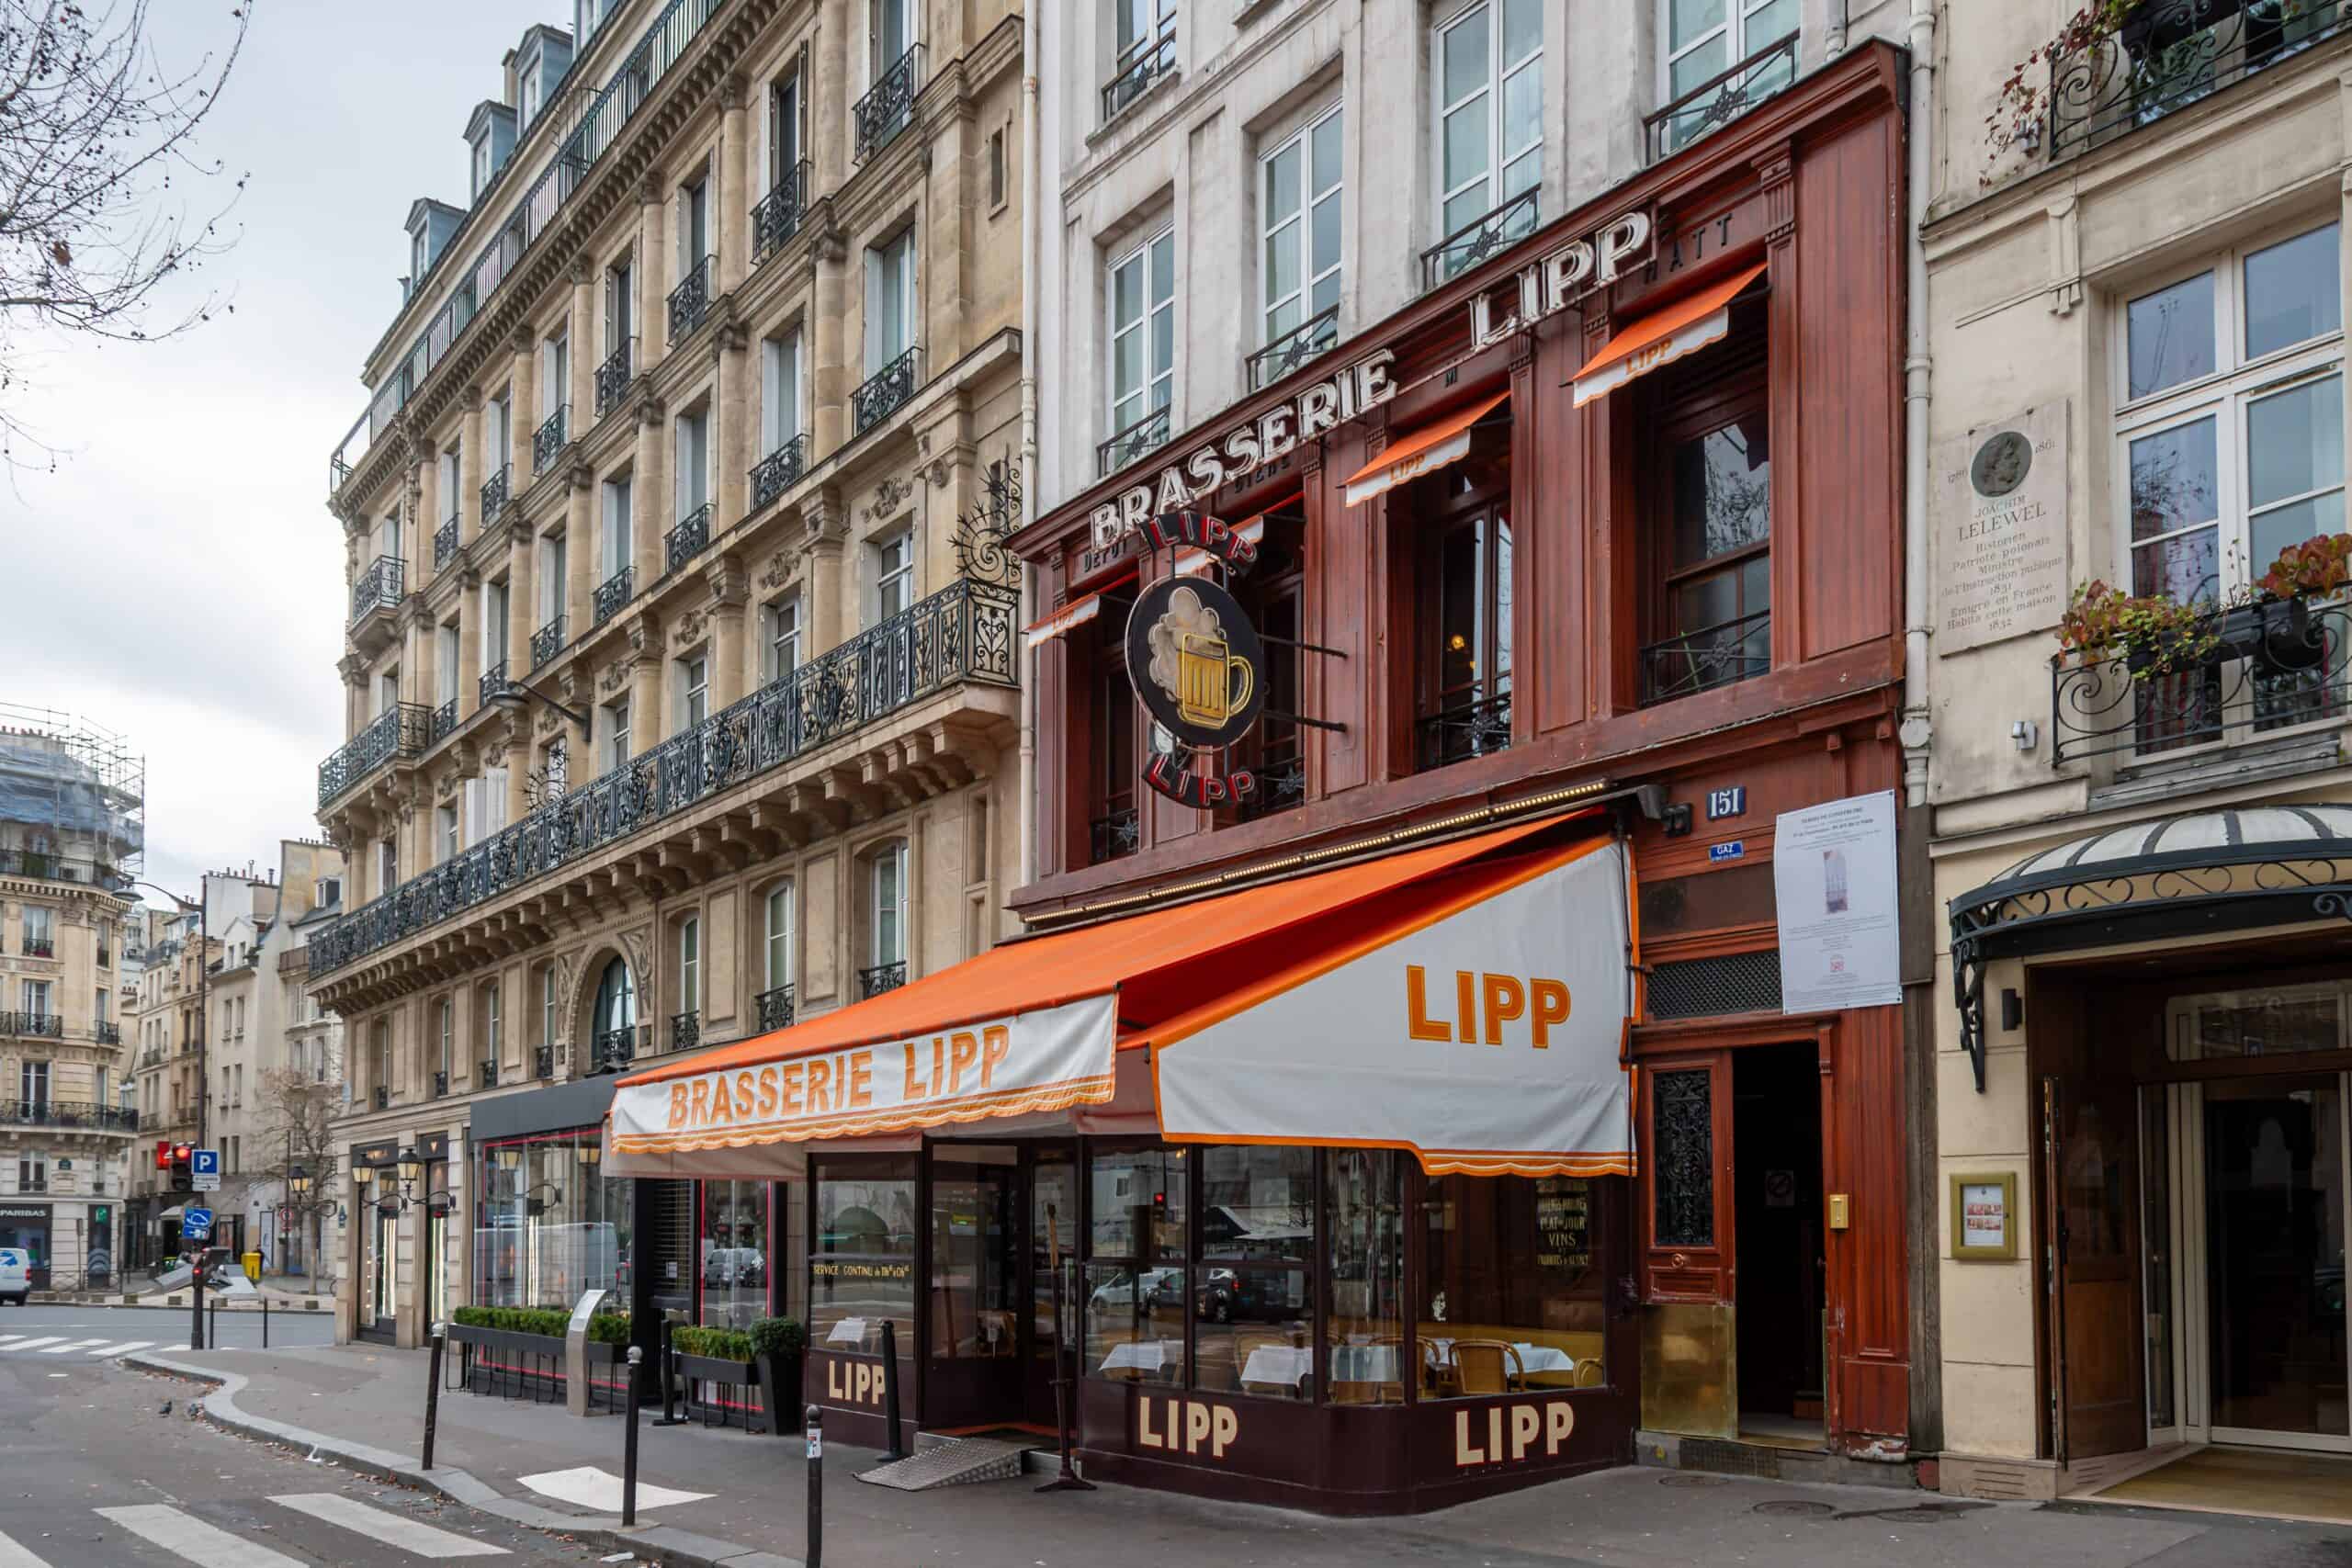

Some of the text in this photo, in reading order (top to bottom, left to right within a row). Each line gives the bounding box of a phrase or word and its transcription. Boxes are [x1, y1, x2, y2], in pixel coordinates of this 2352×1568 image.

[1624, 338, 1672, 376] LIPP
[1090, 211, 1652, 550] BRASSERIE LIPP
[1389, 455, 1426, 481] LIPP
[1957, 501, 2047, 542] LELEWEL
[1974, 494, 2026, 518] JOACHIM
[1149, 509, 1258, 563] LIPP
[1952, 536, 2051, 571] Patriote polonais
[1976, 532, 2026, 553] Historien
[1978, 557, 2023, 574] Ministre
[1996, 595, 2009, 605] en
[2014, 583, 2053, 599] France
[1948, 594, 2057, 631] Habita cette maison
[1149, 752, 1256, 807] LIPP
[1711, 787, 1739, 817] 151
[1716, 843, 1735, 855] GAZ
[1406, 964, 1572, 1050] LIPP
[667, 1024, 1011, 1130] BRASSERIE LIPP
[198, 1155, 211, 1171] P
[1549, 1232, 1577, 1247] VINS
[812, 1264, 839, 1276] SERVICE
[843, 1264, 874, 1277] CONTINU
[829, 1359, 886, 1404] LIPP
[1140, 1396, 1238, 1458] LIPP
[1455, 1402, 1575, 1466] LIPP
